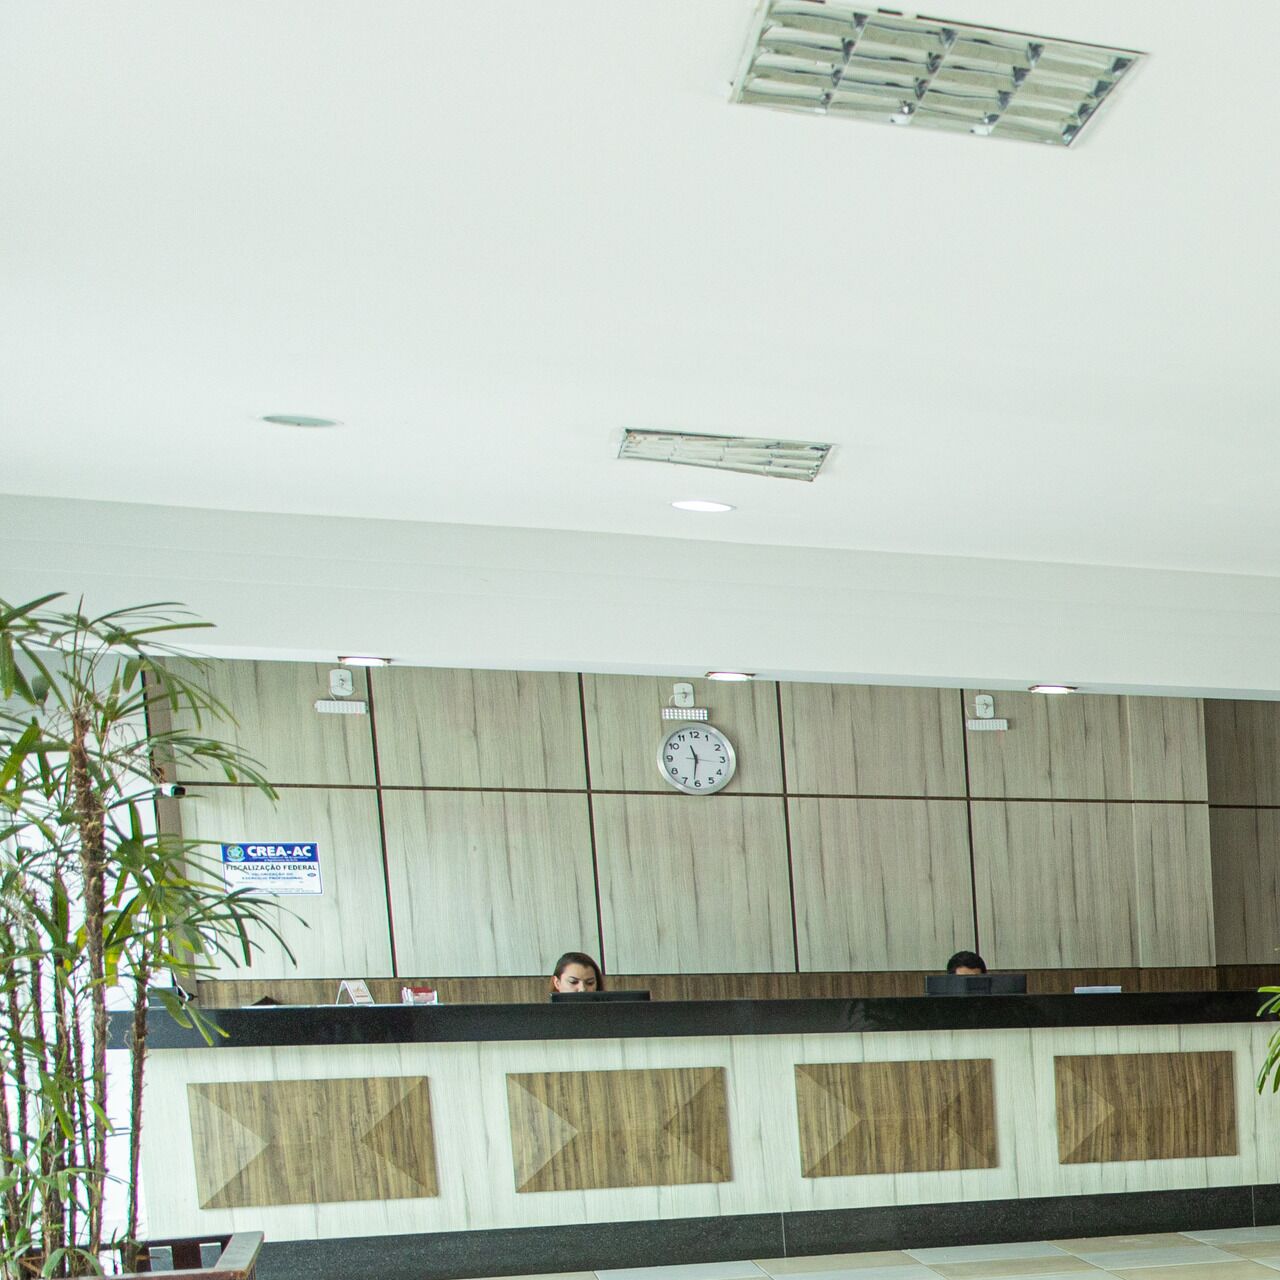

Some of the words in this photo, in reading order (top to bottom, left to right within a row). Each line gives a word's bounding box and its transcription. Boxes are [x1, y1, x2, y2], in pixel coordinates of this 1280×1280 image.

[677, 734, 686, 742] 11
[689, 731, 700, 739] 12
[705, 734, 709, 742] 1
[669, 742, 680, 750] 10
[671, 767, 678, 775] 8
[716, 768, 722, 776] 4
[682, 777, 688, 785] 7
[247, 845, 312, 857] CREA-AC
